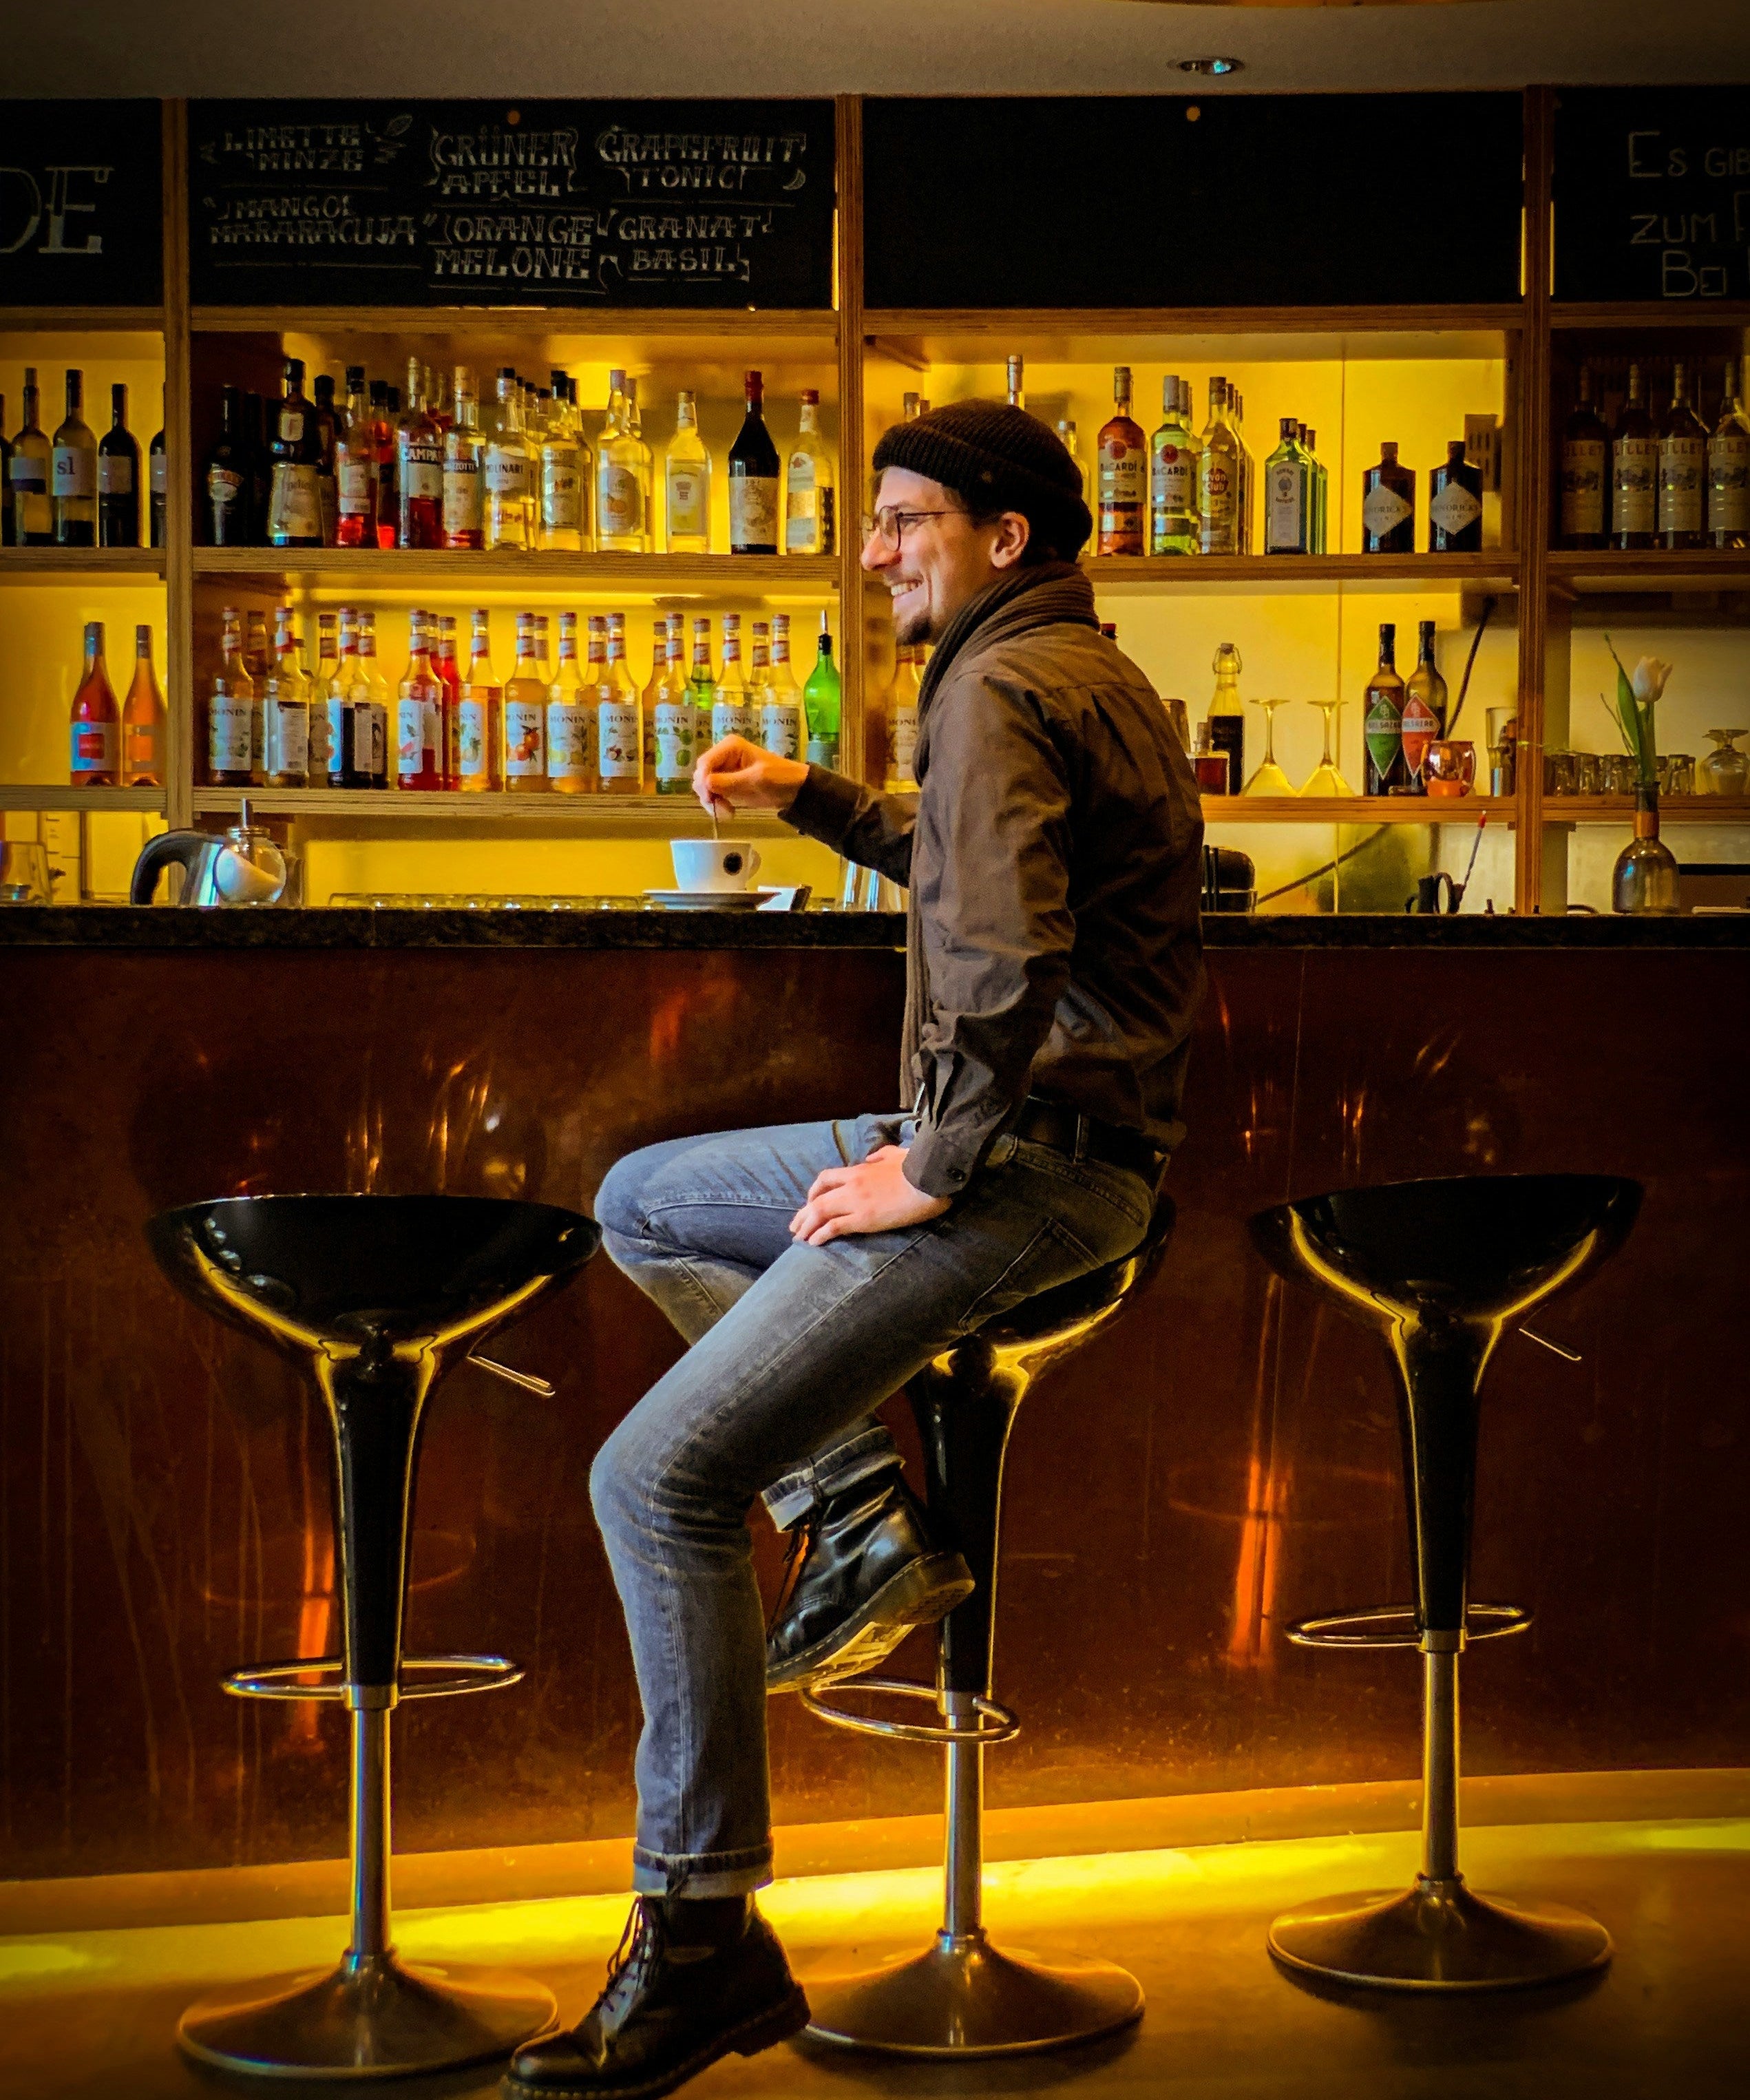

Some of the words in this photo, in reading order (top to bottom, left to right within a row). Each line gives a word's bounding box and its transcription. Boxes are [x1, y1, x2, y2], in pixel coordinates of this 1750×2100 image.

[220, 123, 360, 151] LIMETTE
[435, 125, 574, 167] GRÜNER
[598, 131, 801, 162] GRAPEFRUIT
[257, 148, 363, 171] MINZE
[441, 169, 560, 197] APFEL
[633, 165, 737, 189] TONIC
[453, 214, 594, 245] ORANGE
[618, 214, 761, 241] GRANAT
[434, 246, 592, 279] MELONE
[630, 245, 737, 273] BASIL
